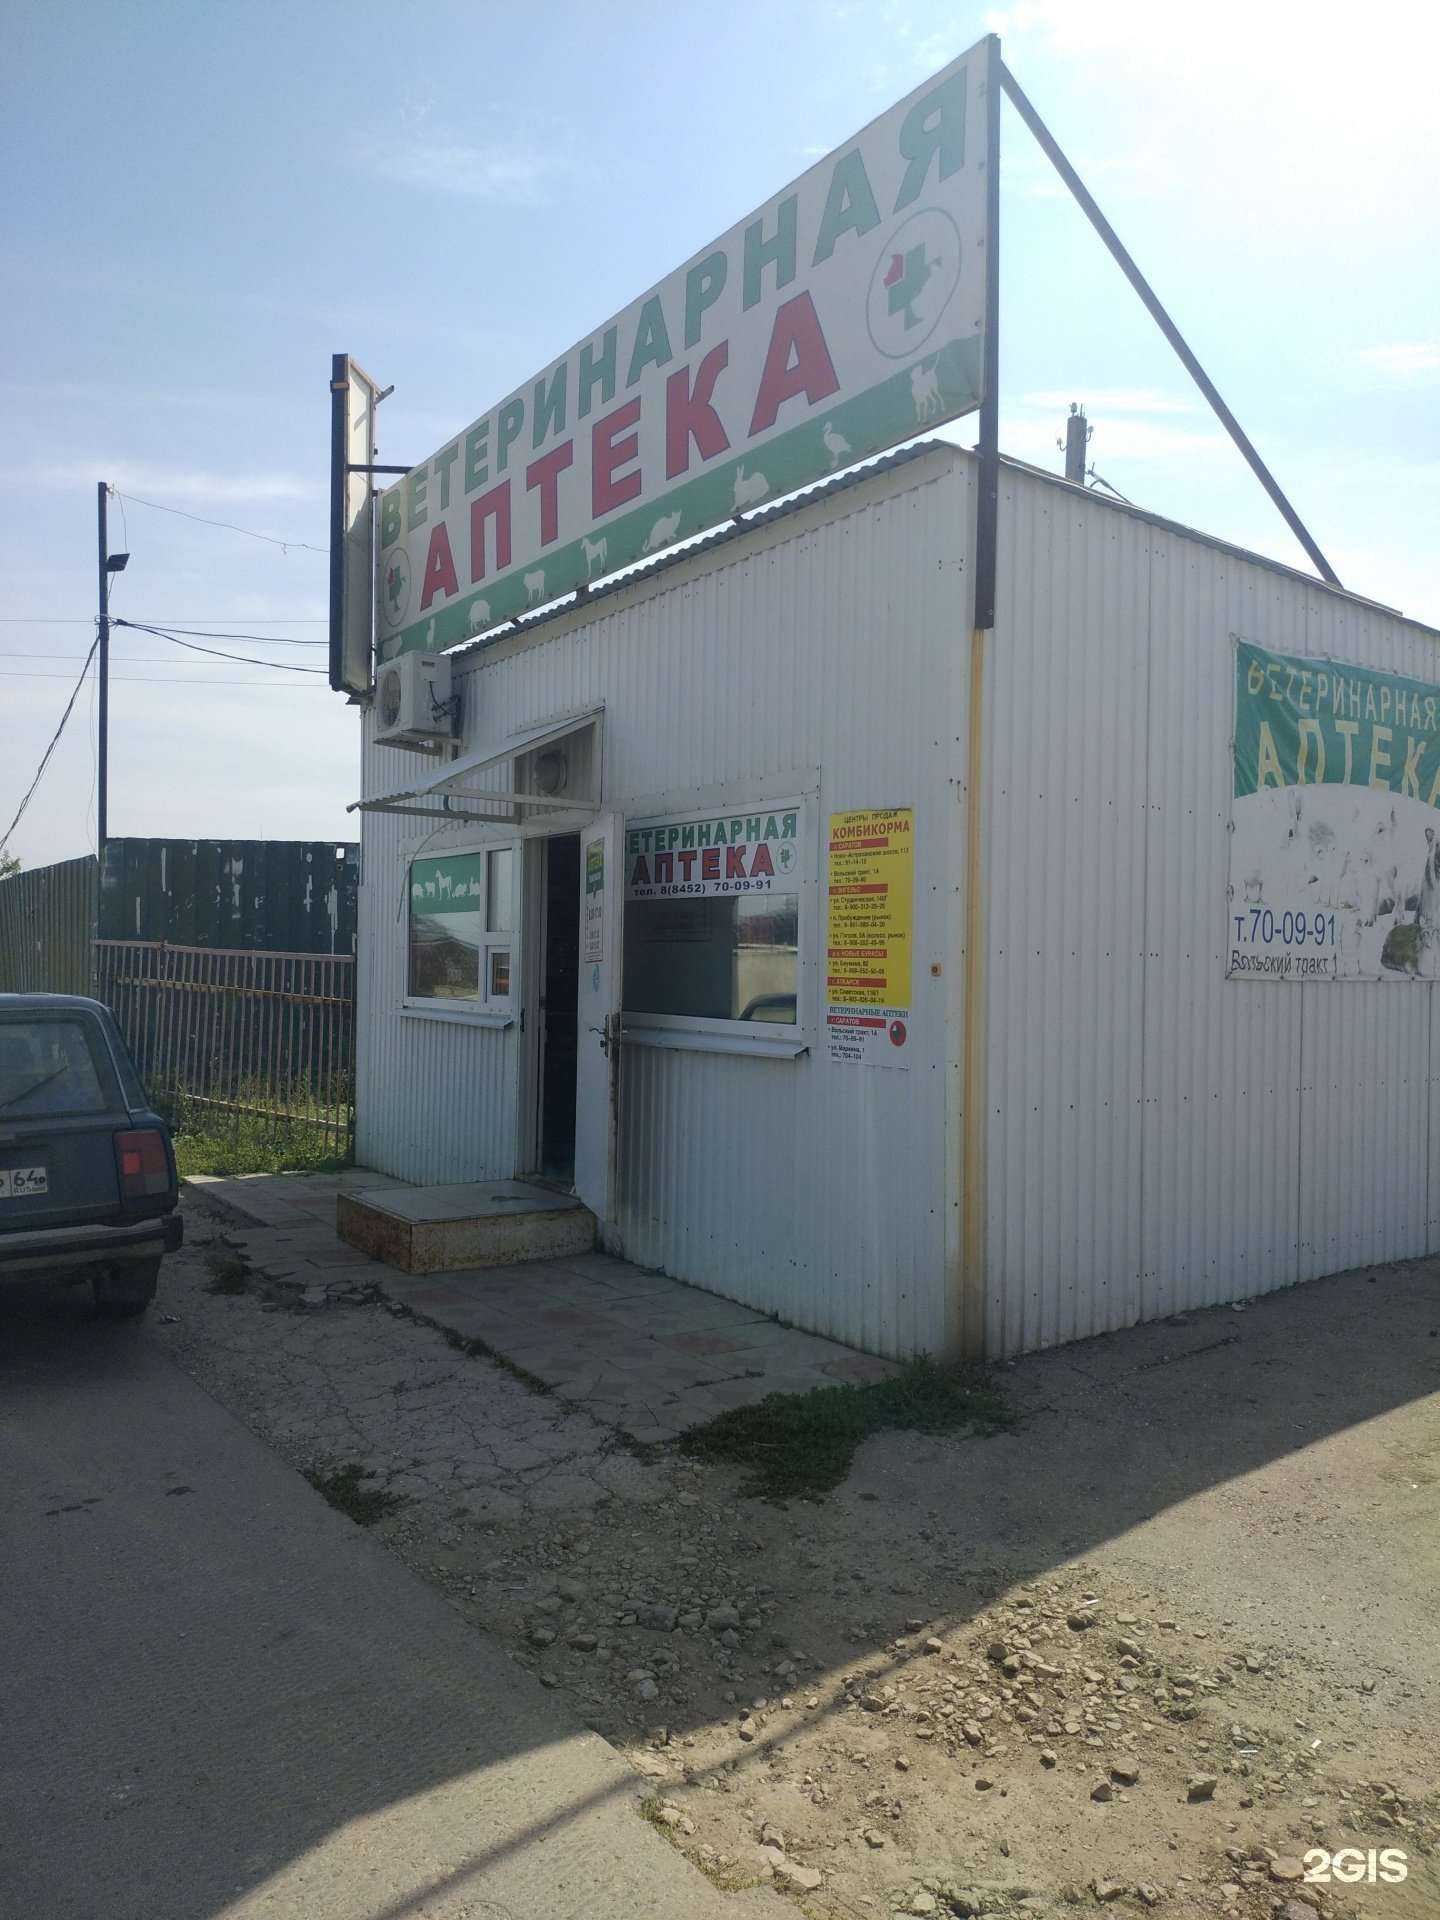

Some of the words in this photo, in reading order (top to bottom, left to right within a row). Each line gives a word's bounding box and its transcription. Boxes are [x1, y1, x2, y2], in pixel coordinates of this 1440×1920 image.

[381, 66, 968, 550] ВЕТЕРИНАРНАЯ
[420, 289, 840, 612] АПТЕКА
[1247, 659, 1437, 732] ВЕТЕРИНАРНАЯ
[628, 813, 797, 854] ЕТЕРИНАРНАЯ
[832, 820, 910, 840] КОМБИКОРМА
[631, 843, 775, 885] АПТЕКА
[660, 883, 706, 896] 8(8452)
[714, 879, 772, 892] 70-09-91
[1234, 908, 1336, 946] т.70-09-91
[1231, 949, 1292, 974] Вольский
[1296, 957, 1329, 977] тракт
